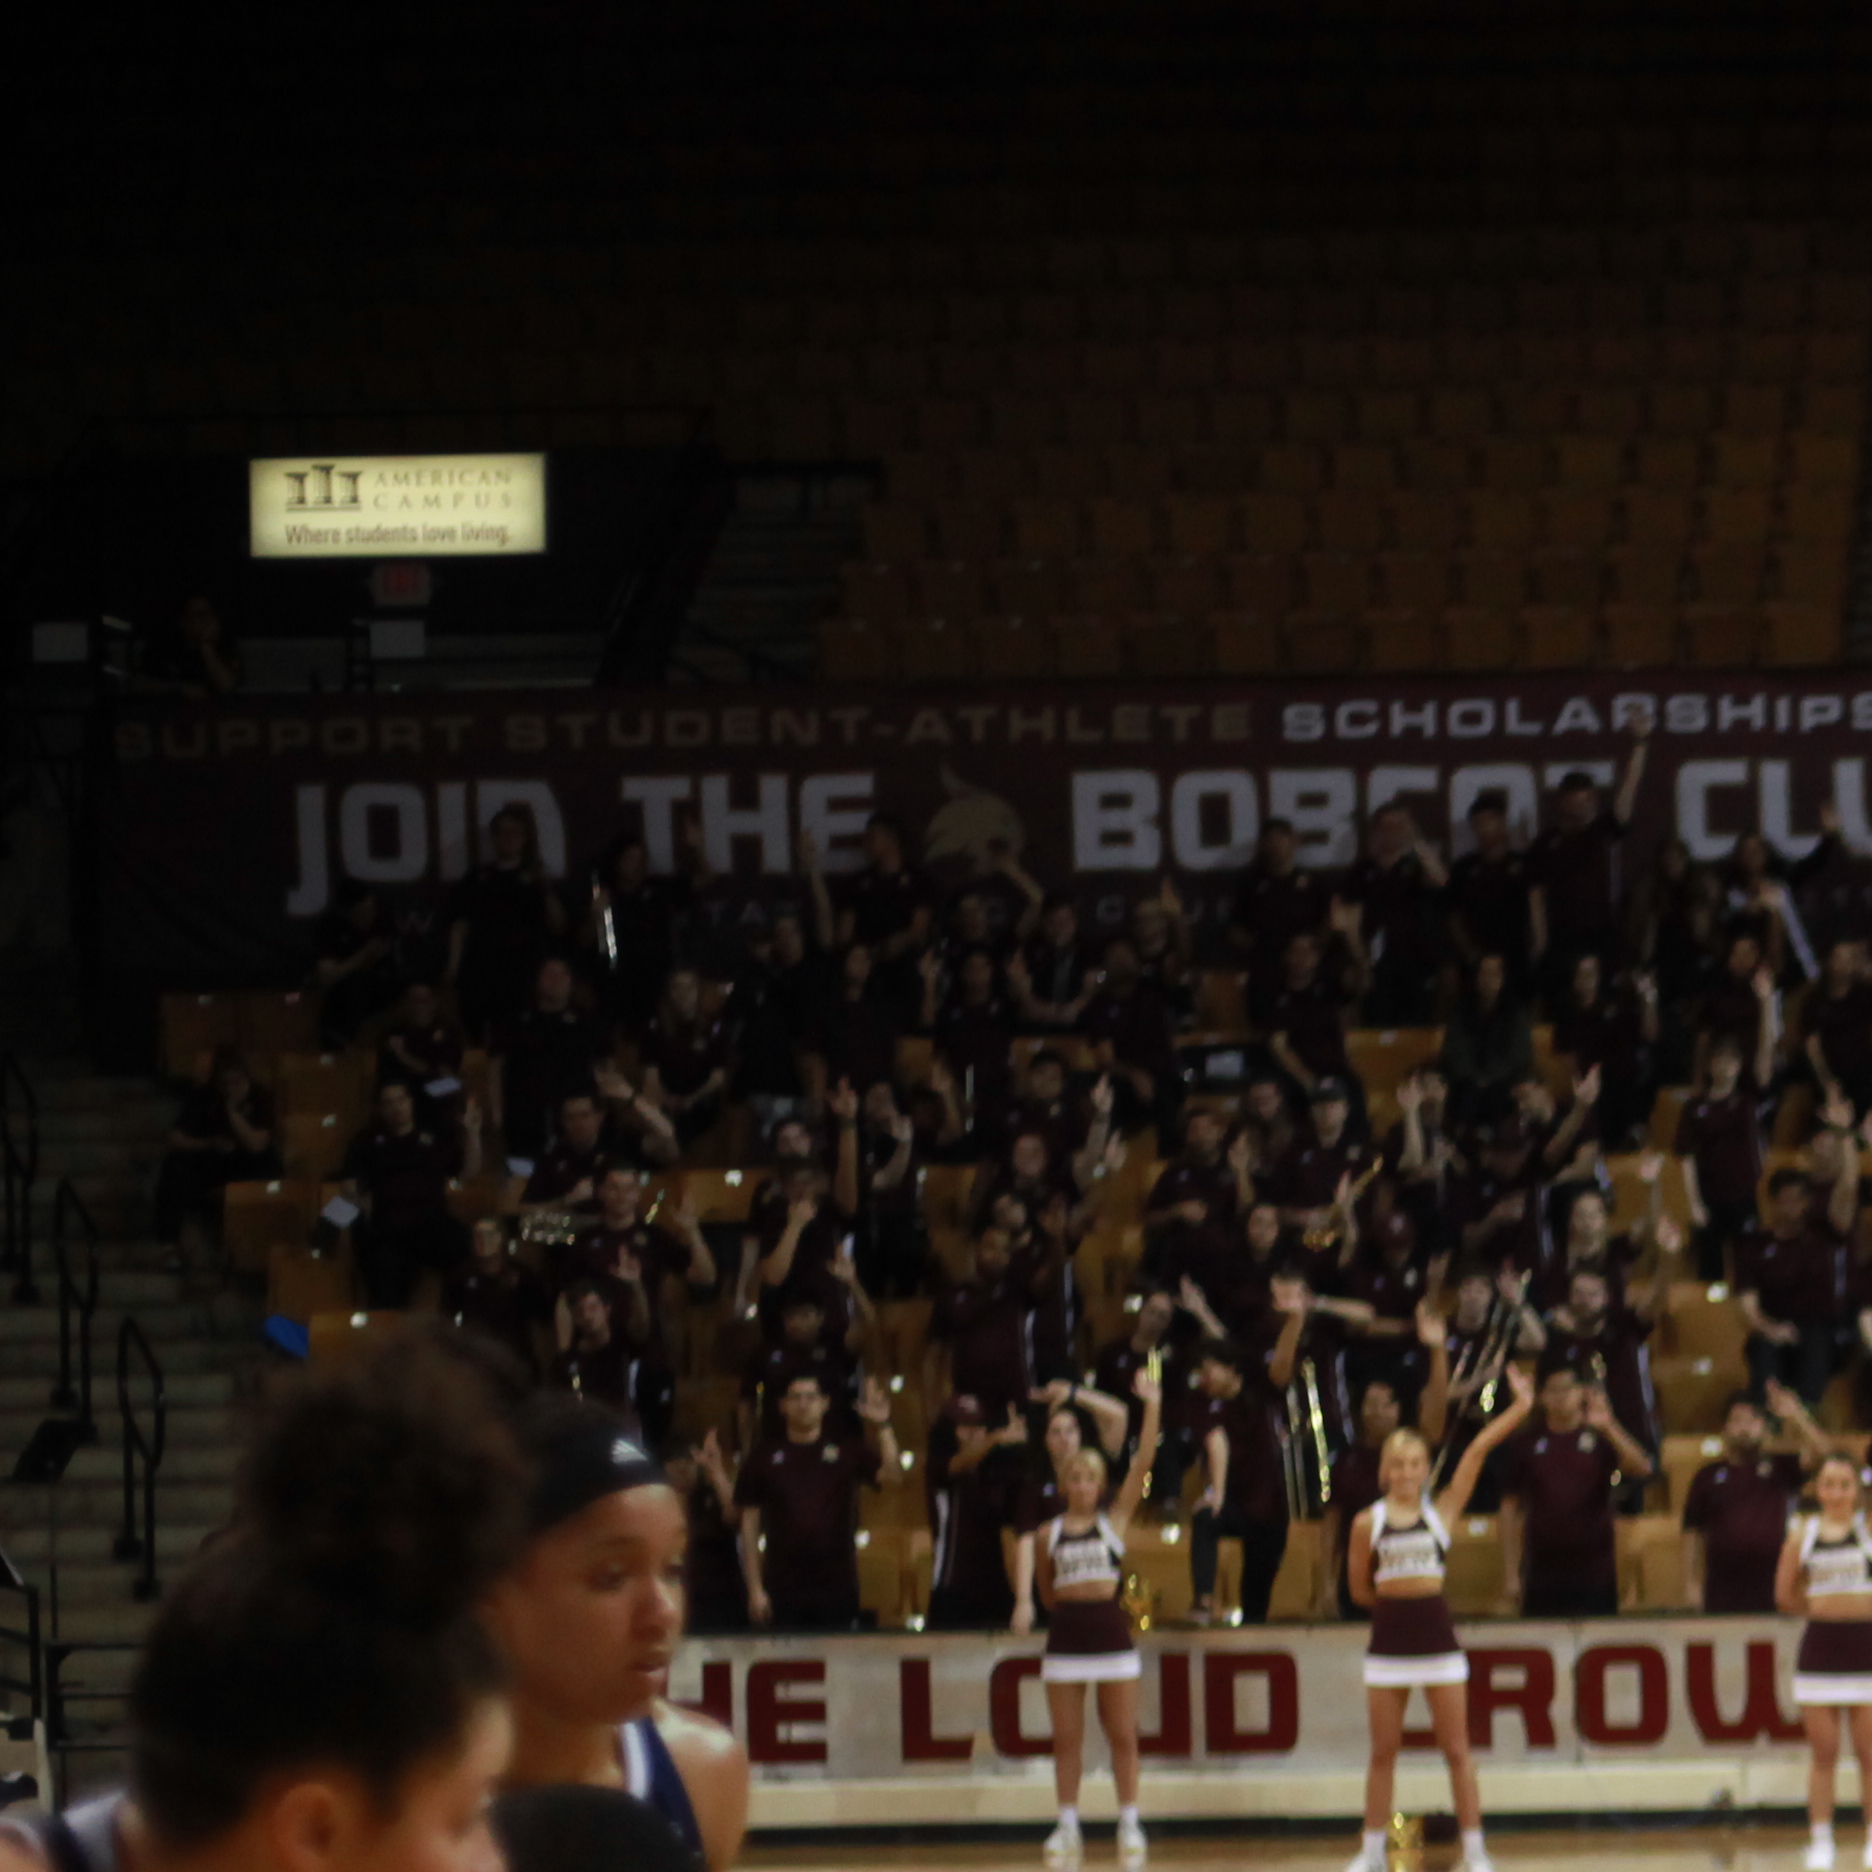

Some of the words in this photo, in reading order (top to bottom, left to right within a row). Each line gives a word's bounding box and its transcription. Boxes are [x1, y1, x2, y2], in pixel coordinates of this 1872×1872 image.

[374, 468, 511, 487] AMERICAN
[374, 492, 511, 511] CAMPUS
[285, 524, 341, 544] Where
[345, 523, 418, 544] students
[422, 522, 458, 543] love
[112, 716, 475, 763] SUPPORT
[505, 702, 1252, 753] STUDENT-ATHLETE
[620, 770, 877, 877] THE
